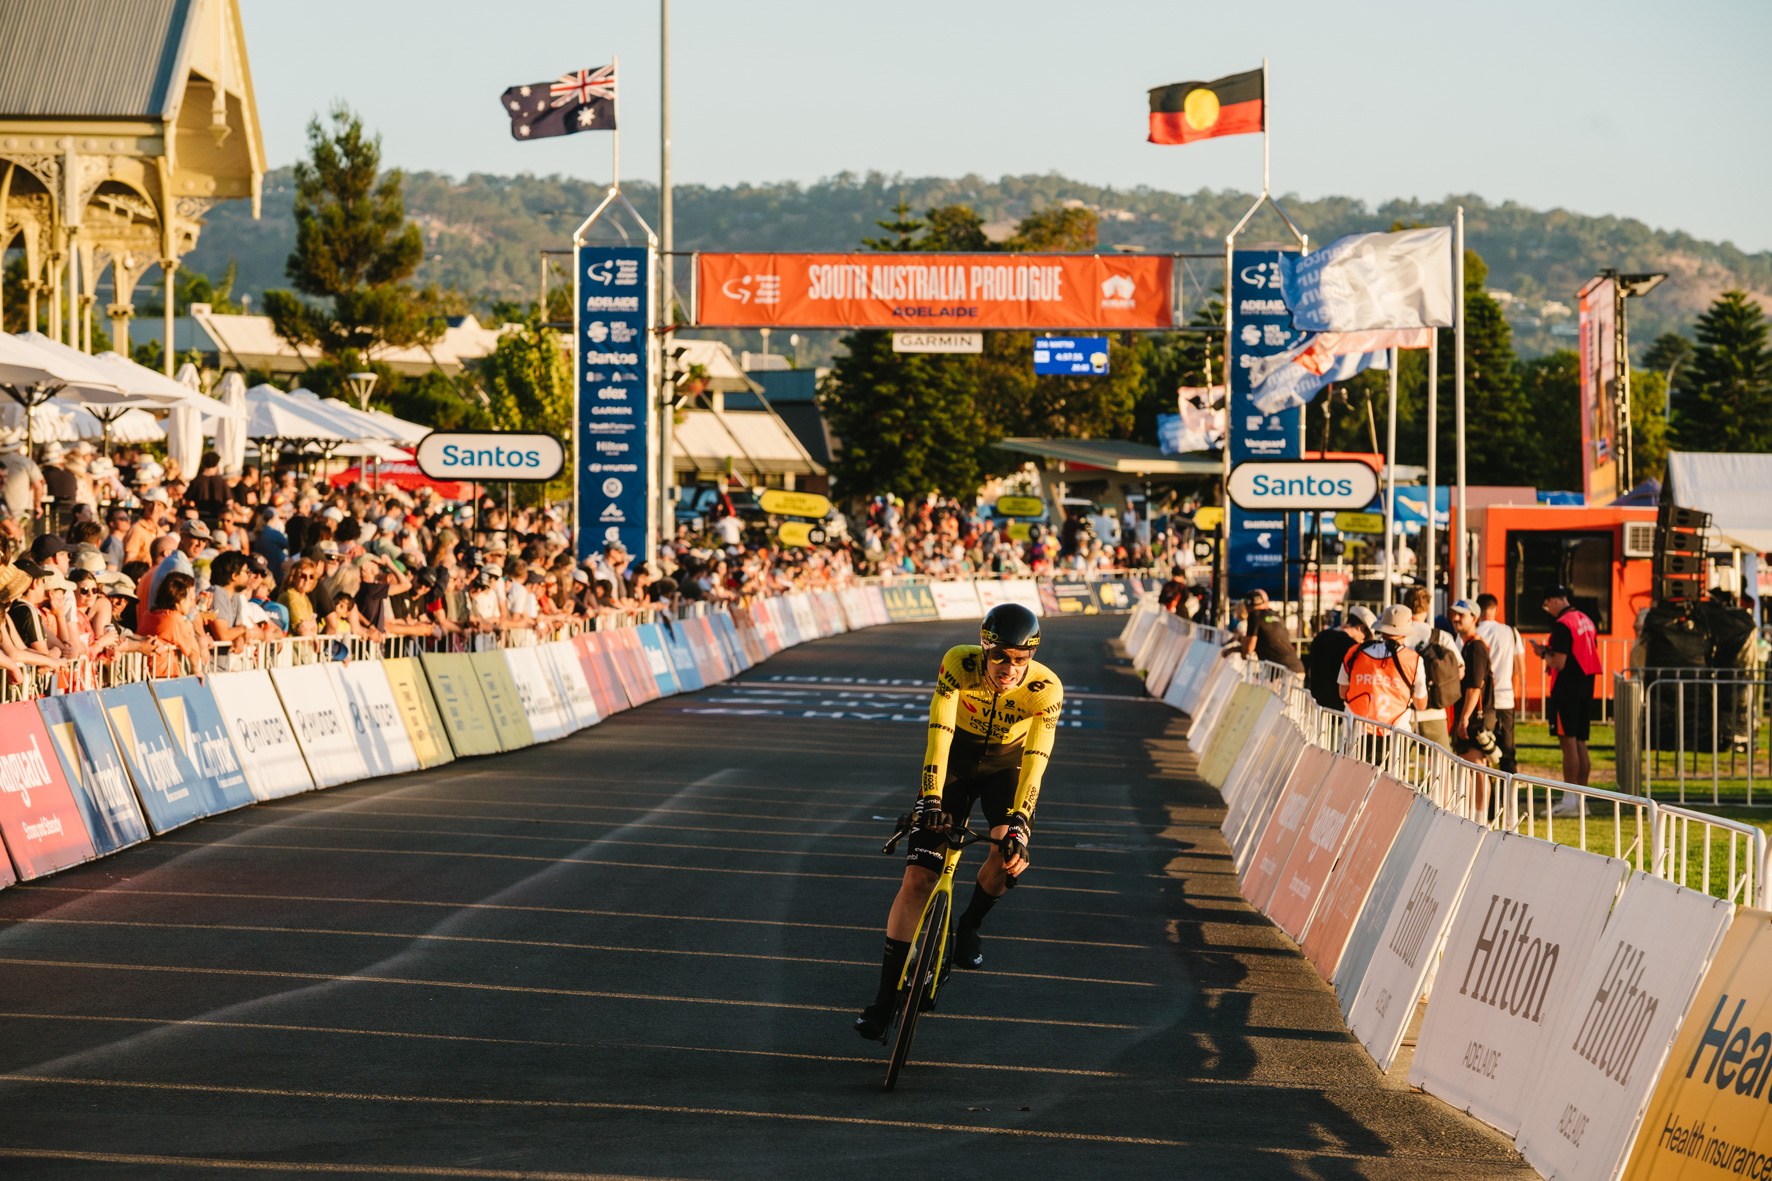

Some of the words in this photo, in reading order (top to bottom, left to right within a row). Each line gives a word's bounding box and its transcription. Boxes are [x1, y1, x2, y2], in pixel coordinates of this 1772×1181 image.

[808, 264, 867, 300] SOUTH
[870, 264, 967, 301] AUSTRALIA
[970, 265, 1063, 301] PROLOGUE
[892, 306, 979, 317] ADELAIDE
[1240, 300, 1286, 310] ADELAID
[900, 335, 972, 347] GARMIN
[442, 445, 540, 467] Santos
[1252, 474, 1353, 496] Santos
[1355, 673, 1401, 688] PRESS
[1043, 702, 1061, 714] VISM
[248, 716, 290, 748] HYUNDAI
[1308, 788, 1355, 863] Vanguard
[1389, 863, 1439, 969] Hilton
[1459, 894, 1560, 1023] Hilton
[1572, 940, 1659, 1086] Hilton
[1462, 1040, 1502, 1080] ADELAIDE
[1658, 1112, 1705, 1160] Health
